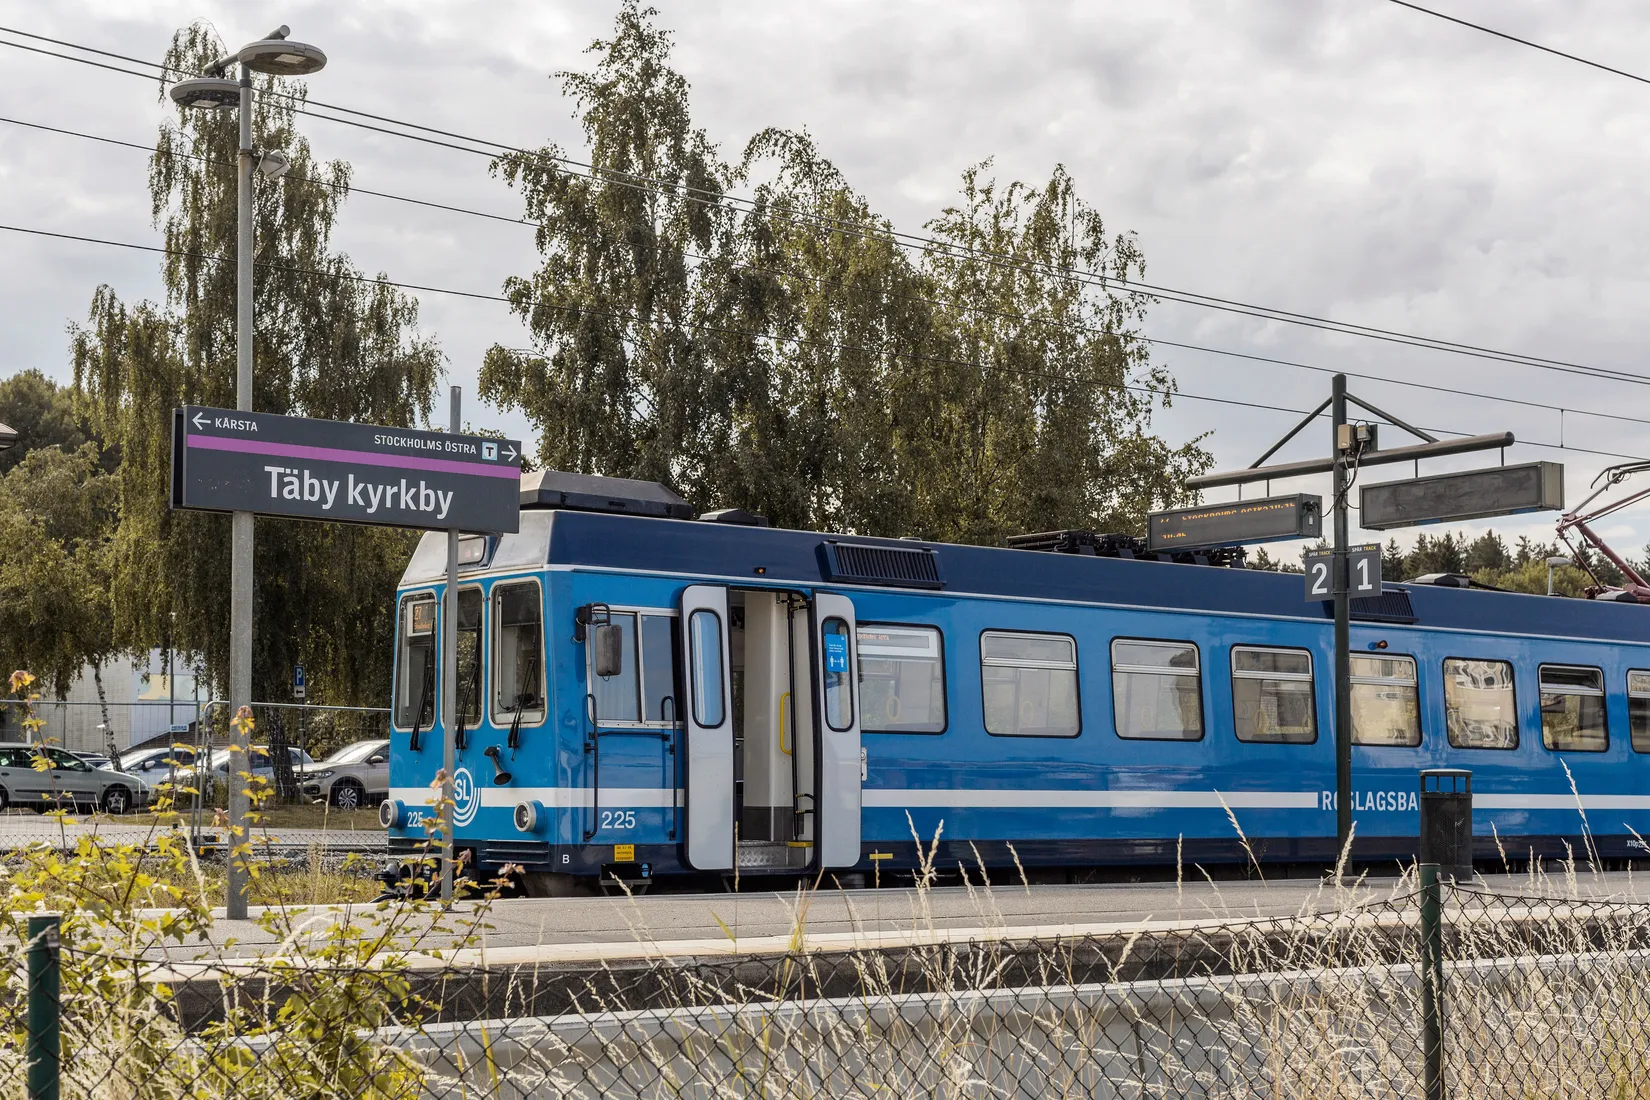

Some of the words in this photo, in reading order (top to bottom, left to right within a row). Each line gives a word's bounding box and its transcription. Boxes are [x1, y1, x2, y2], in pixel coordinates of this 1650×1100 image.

[215, 416, 258, 432] KÅRSTA
[374, 434, 442, 451] STOCKHOLMS
[445, 441, 477, 455] ÖSTRA
[264, 465, 340, 510] Täby
[348, 473, 454, 520] kyrkby
[1311, 562, 1328, 595] 2
[1356, 558, 1373, 591] 1
[296, 667, 303, 685] P
[454, 778, 470, 801] SL
[1322, 790, 1421, 812] RLAGSBA
[407, 811, 424, 828] 225
[601, 810, 636, 830] 225
[562, 854, 570, 864] B
